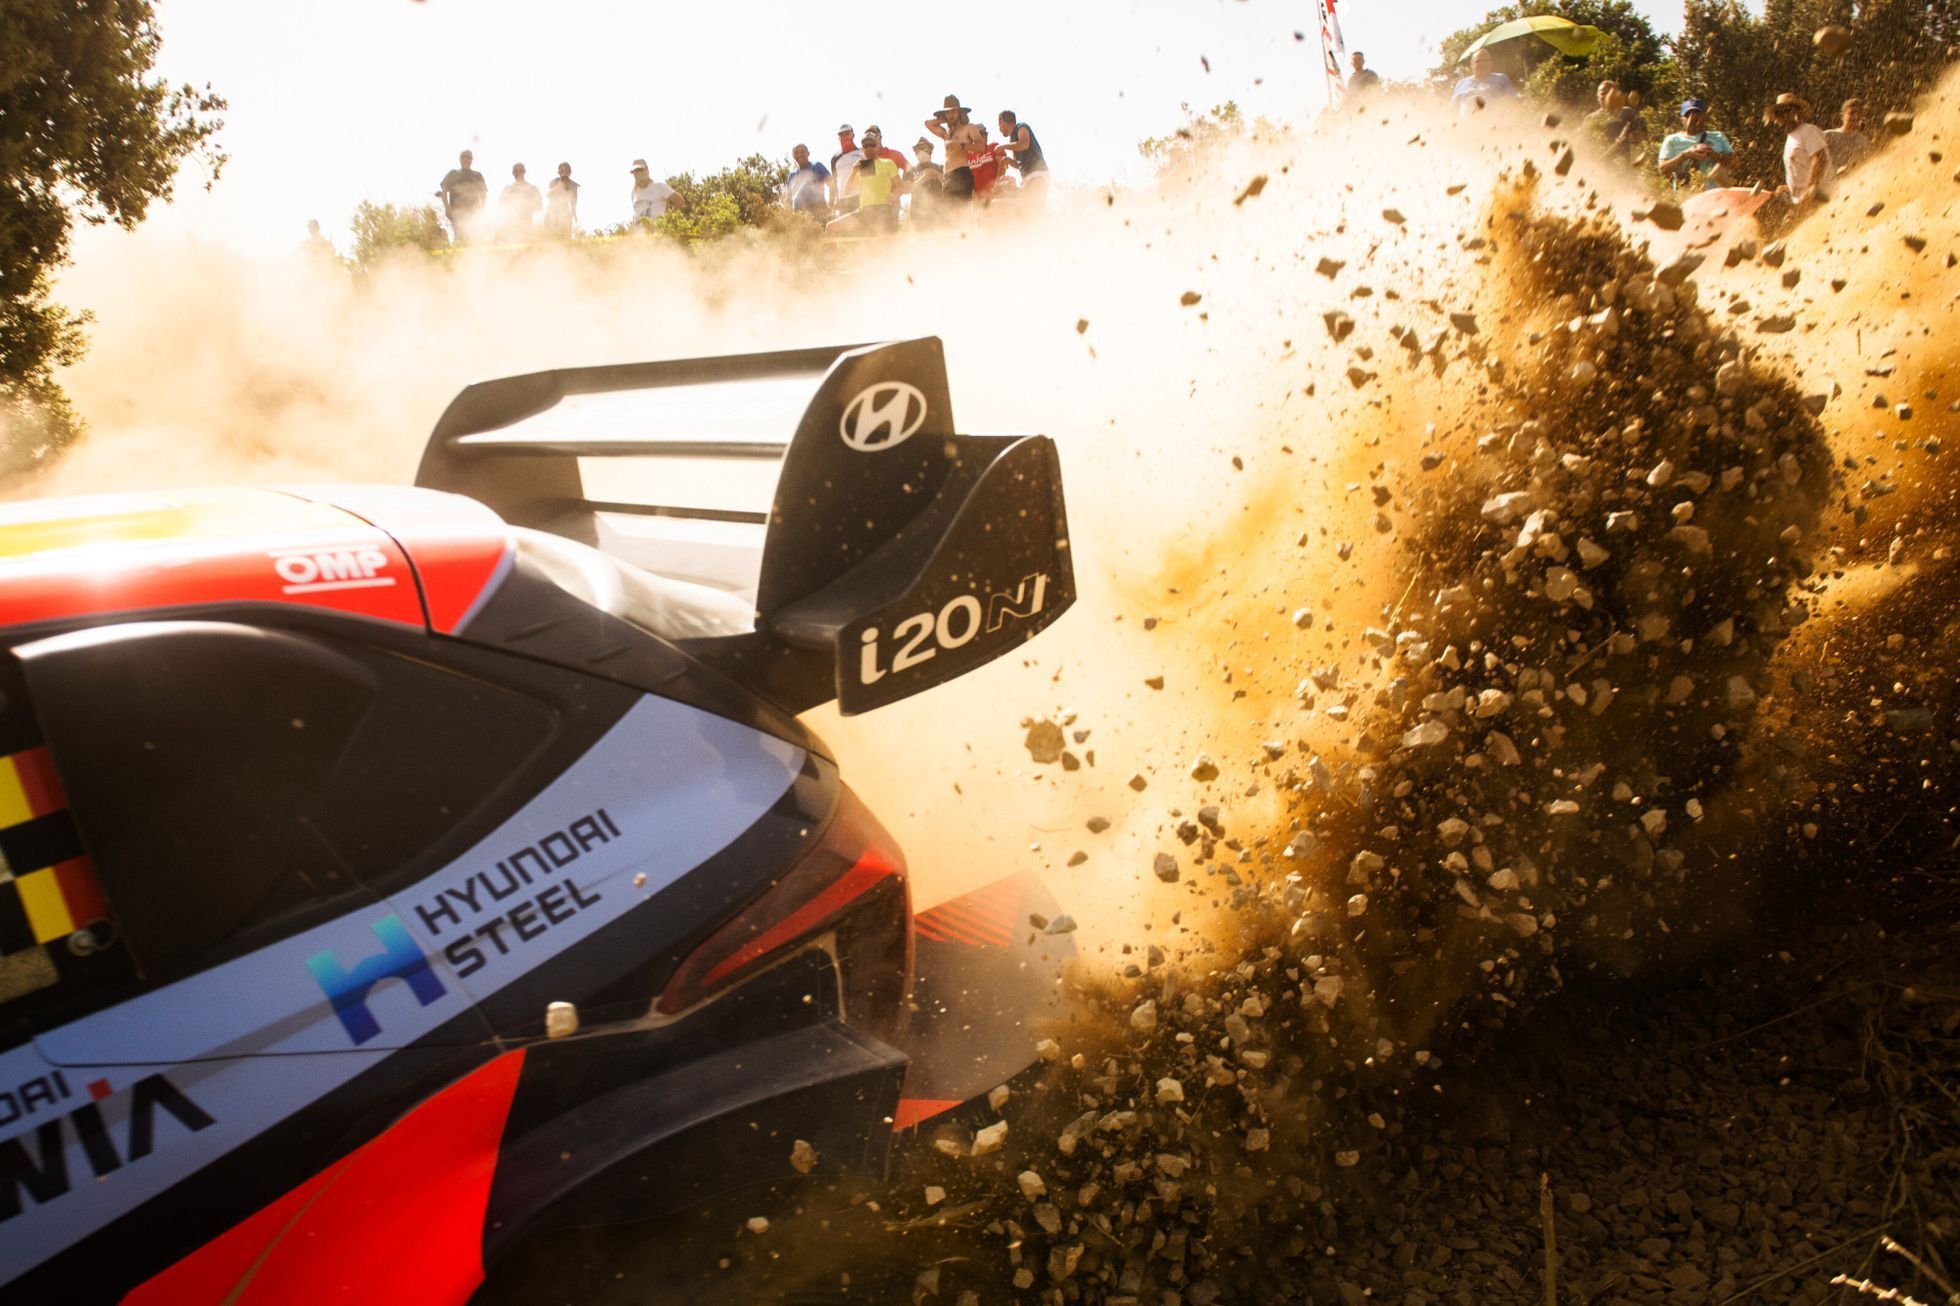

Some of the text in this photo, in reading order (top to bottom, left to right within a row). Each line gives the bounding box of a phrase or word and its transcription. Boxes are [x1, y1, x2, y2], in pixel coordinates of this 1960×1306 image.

[275, 550, 388, 584] OMP
[414, 808, 622, 935] HYUNDAI
[443, 878, 602, 979] STEEL
